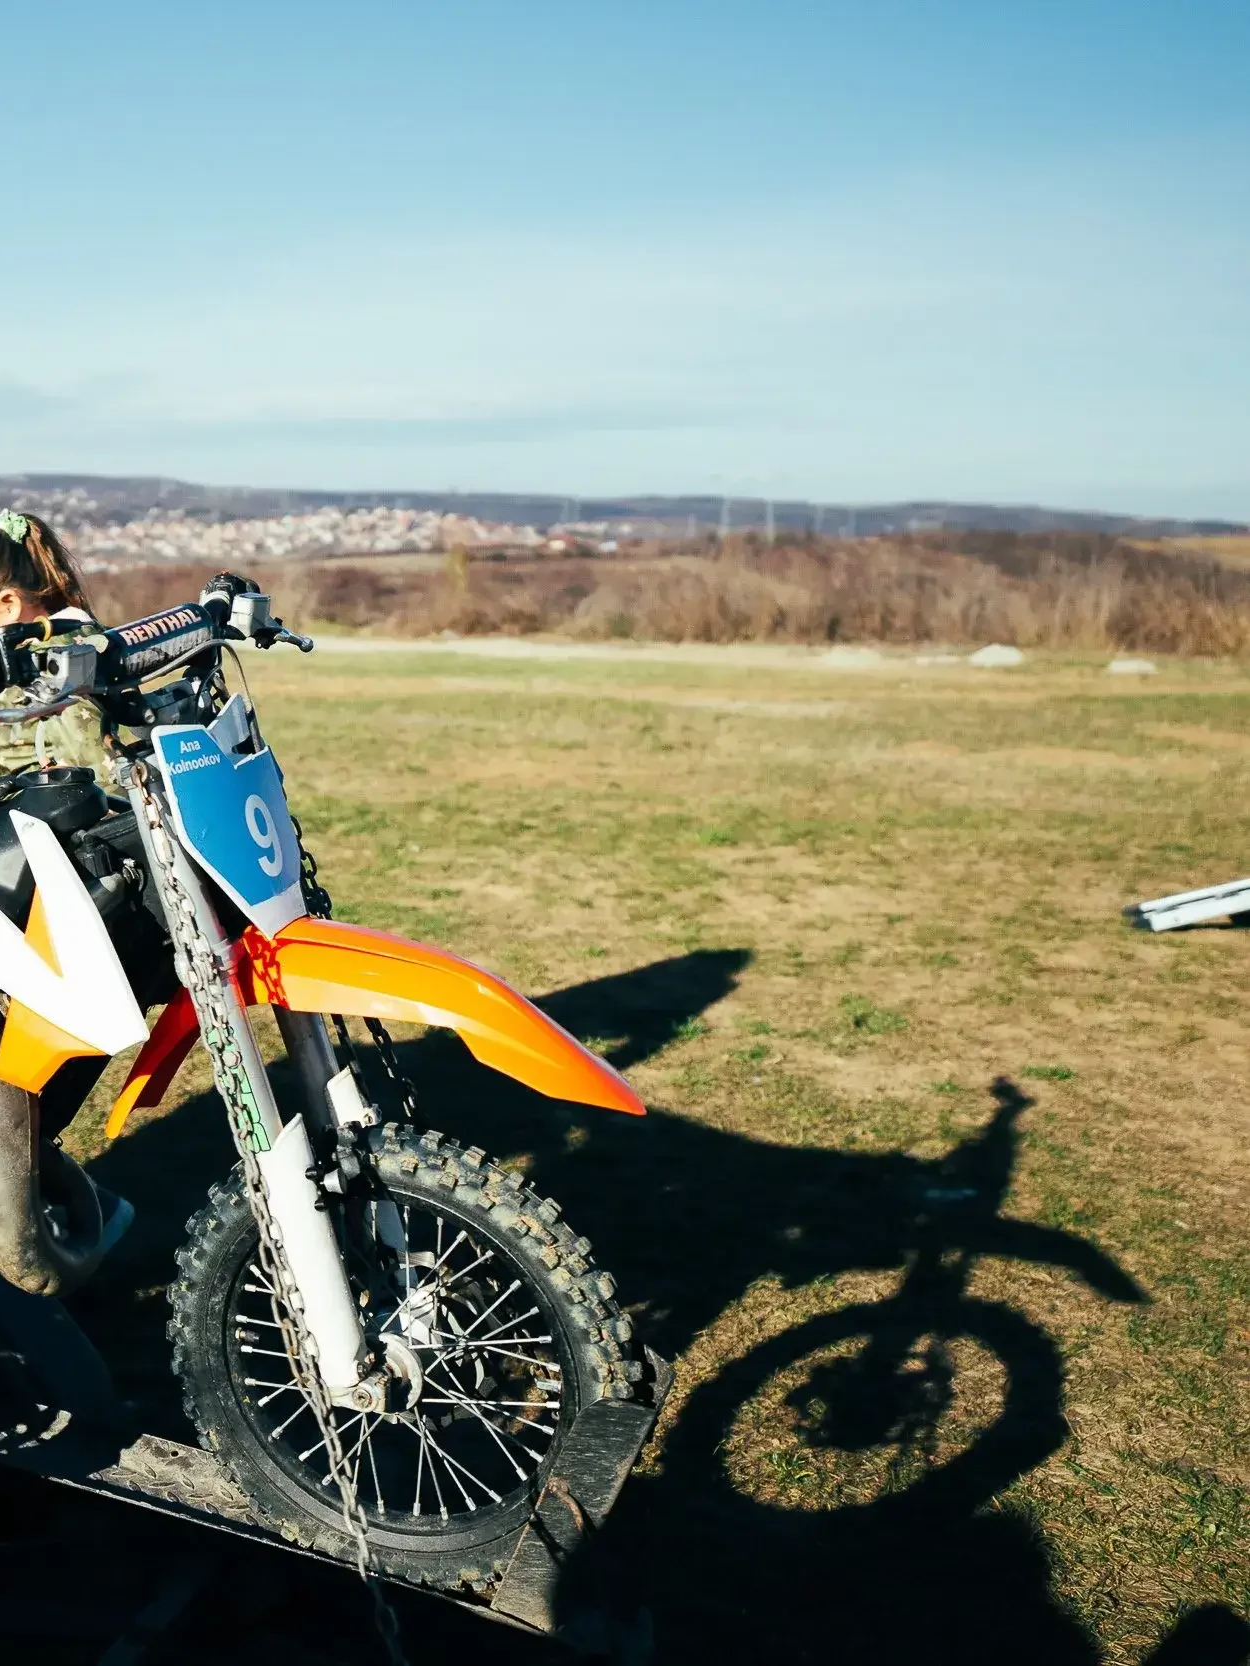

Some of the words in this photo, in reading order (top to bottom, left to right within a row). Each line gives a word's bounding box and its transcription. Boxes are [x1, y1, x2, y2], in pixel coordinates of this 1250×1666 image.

[119, 608, 203, 646] RENTHAL
[179, 740, 201, 754] Ana
[245, 794, 283, 877] 9
